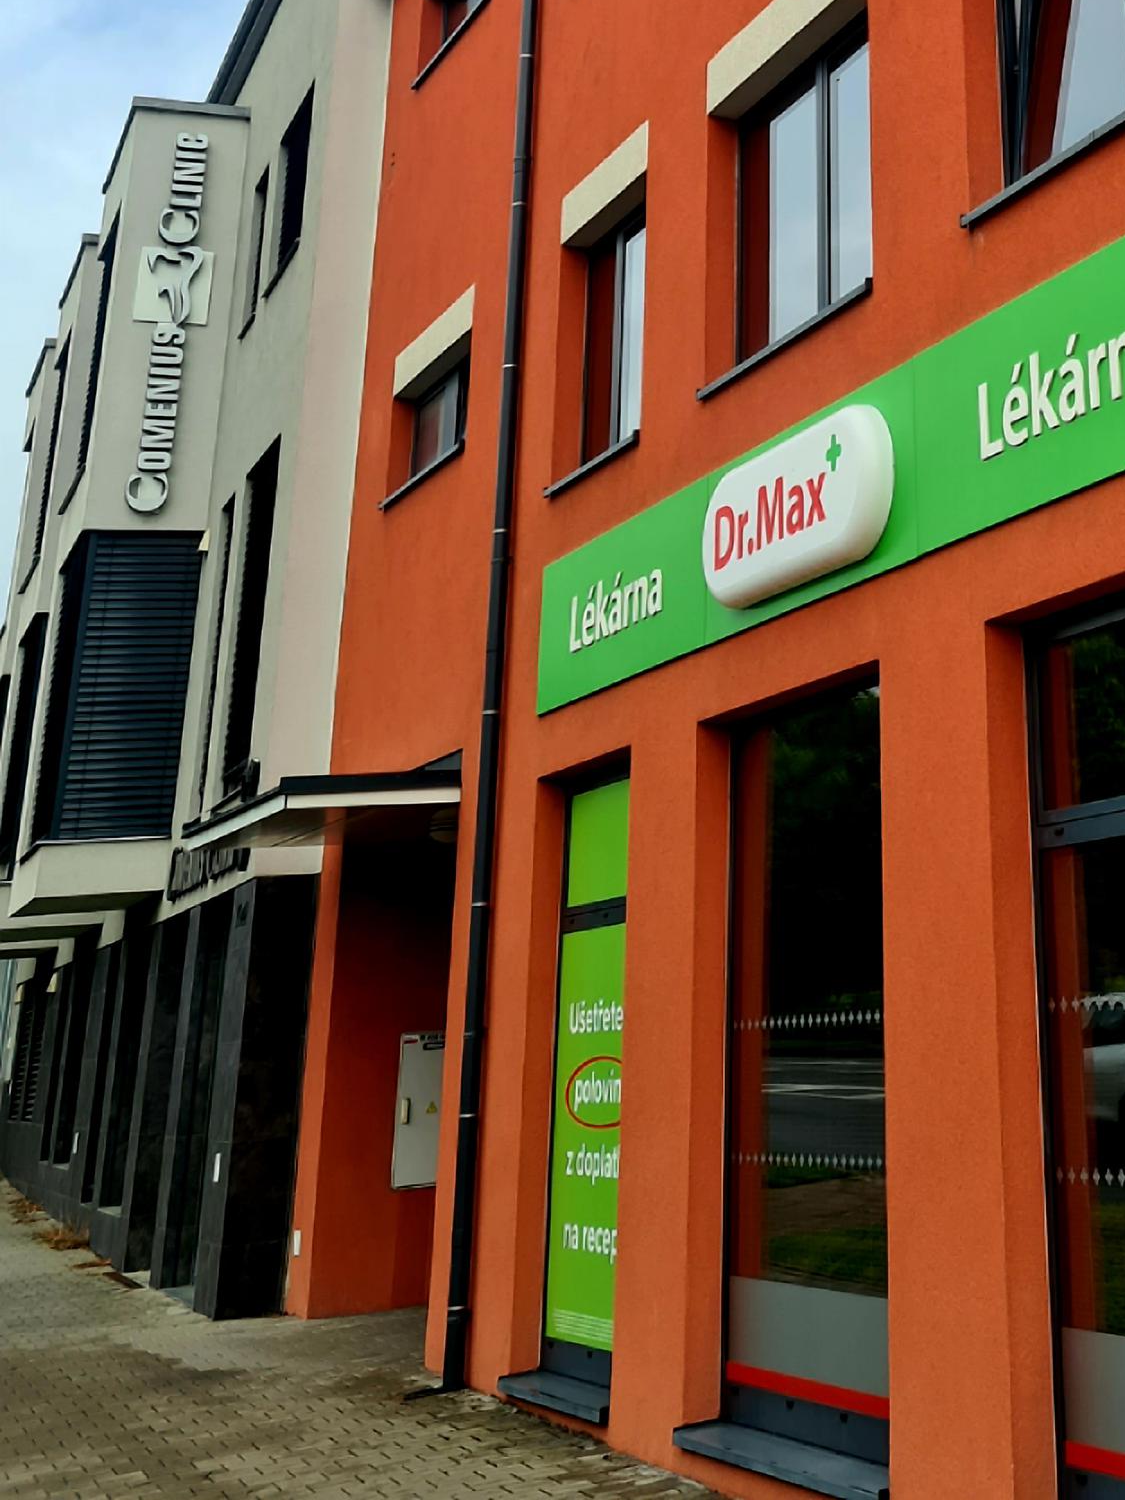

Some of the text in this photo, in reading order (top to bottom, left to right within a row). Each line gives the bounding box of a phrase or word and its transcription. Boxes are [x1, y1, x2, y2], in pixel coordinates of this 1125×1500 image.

[158, 132, 208, 245] CLINIC
[713, 470, 827, 571] Dr.Max
[568, 567, 663, 652] Lékárna
[569, 999, 624, 1034] Ušetřete
[566, 1151, 574, 1175] z
[563, 1223, 578, 1250] na
